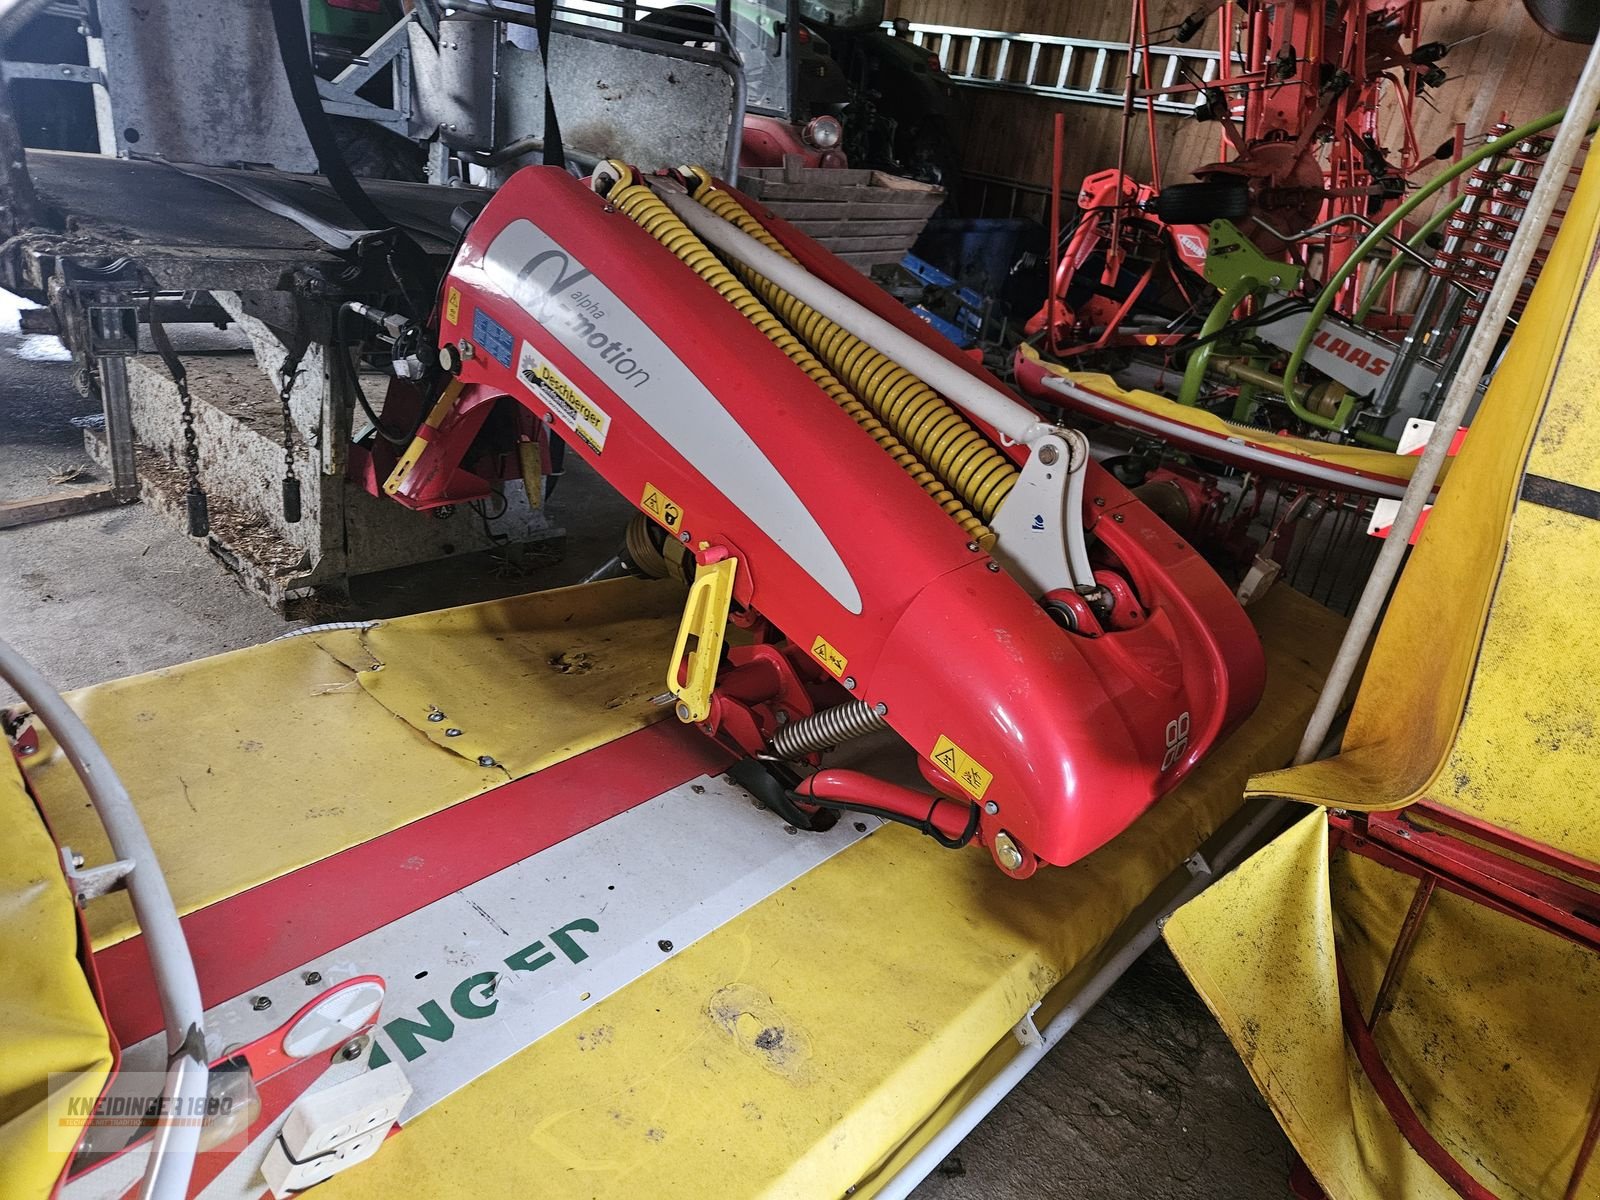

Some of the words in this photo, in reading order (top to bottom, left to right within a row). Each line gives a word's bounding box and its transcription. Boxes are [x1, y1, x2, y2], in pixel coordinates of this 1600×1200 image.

[570, 290, 605, 320] alpha
[1313, 331, 1391, 376] LAAS
[542, 367, 600, 426] Deschberger
